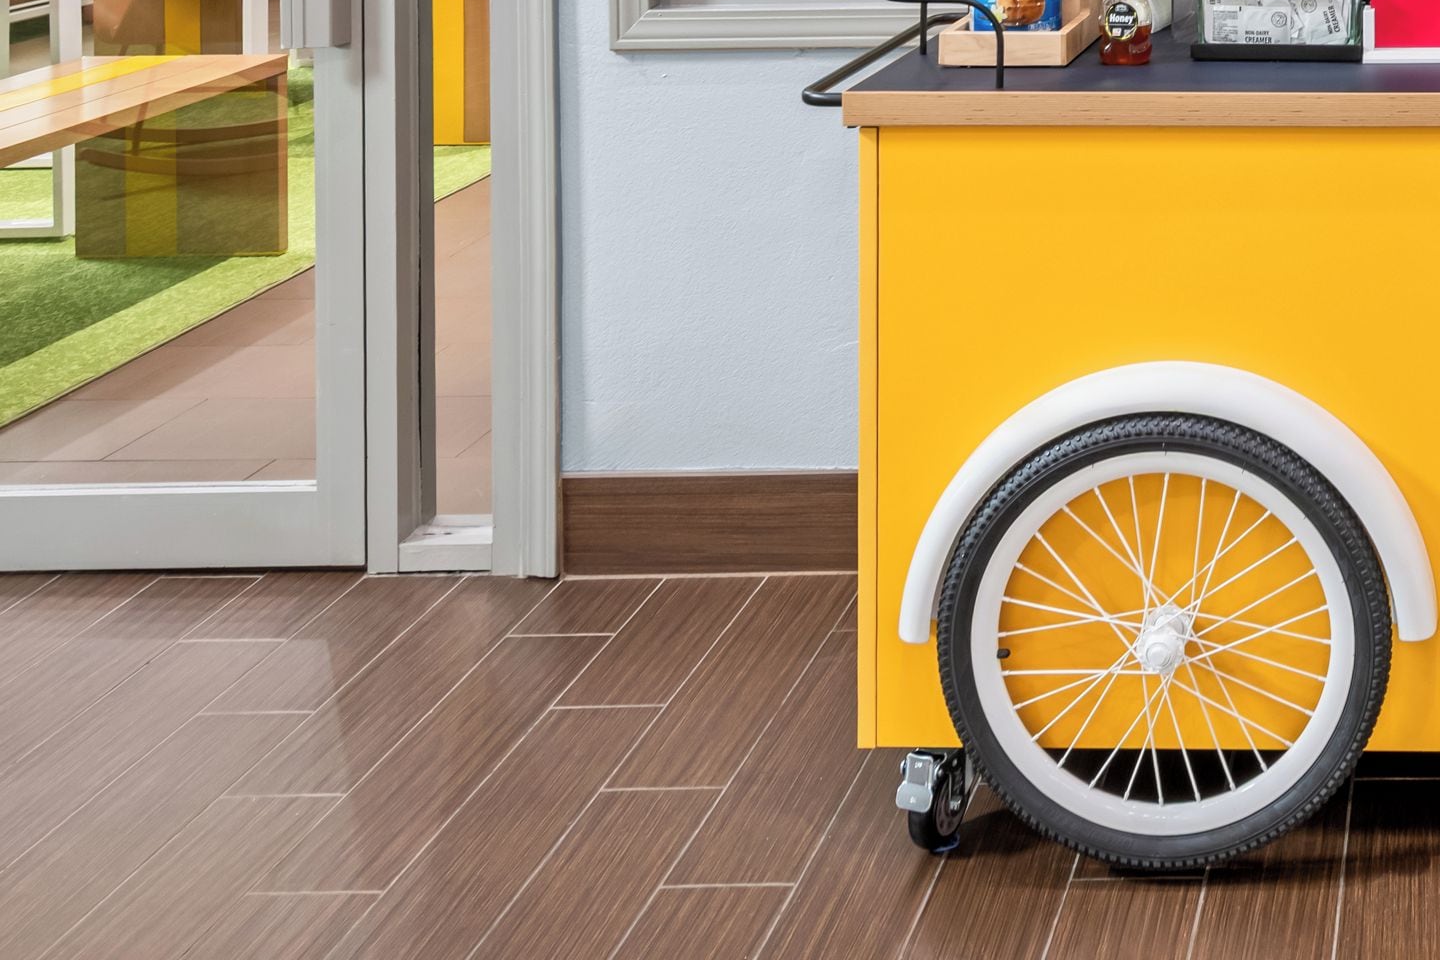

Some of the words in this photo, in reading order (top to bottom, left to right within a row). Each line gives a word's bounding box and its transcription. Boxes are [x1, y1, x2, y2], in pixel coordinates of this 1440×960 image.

[1109, 13, 1134, 25] Honey
[1327, 5, 1341, 33] CREAMER
[1244, 36, 1272, 44] CREAMER
